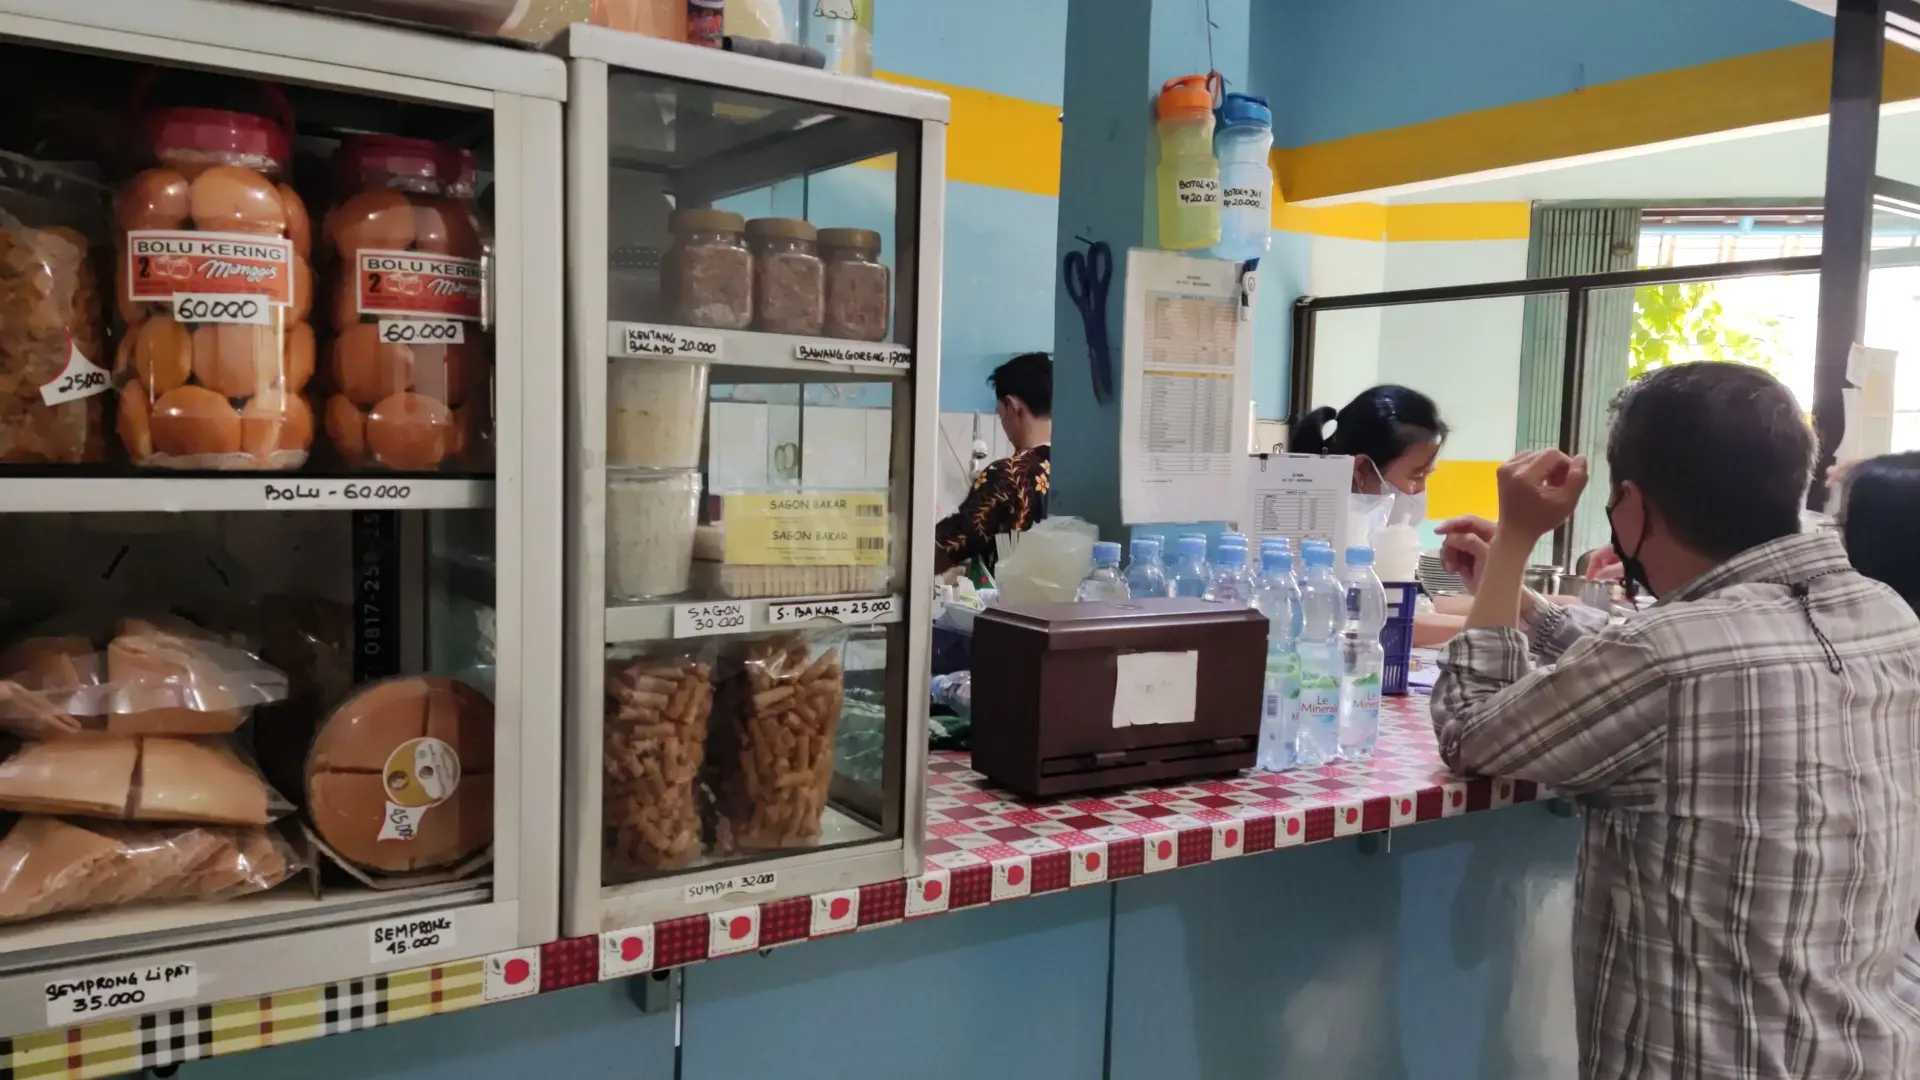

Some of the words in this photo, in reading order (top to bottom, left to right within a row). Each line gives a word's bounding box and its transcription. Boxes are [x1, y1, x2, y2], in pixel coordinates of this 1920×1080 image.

[137, 241, 193, 253] BOLU
[201, 242, 282, 260] KERING
[368, 258, 423, 272] BOLU
[384, 323, 457, 341] 60.000
[628, 329, 677, 345] KENTANG
[629, 340, 675, 355] BALADO
[800, 345, 843, 360] BAWANG
[769, 499, 810, 510] SAGON
[813, 499, 847, 509] BAKAR
[771, 530, 812, 541] SAGON
[815, 531, 848, 541] BAKAR
[688, 604, 741, 619] SAGON
[794, 606, 840, 618] BAKAR
[851, 601, 891, 614] 25.000
[1317, 695, 1328, 705] Le
[374, 917, 452, 943] SEMPRONG
[386, 934, 440, 955] 45.000
[45, 972, 138, 1001] SEMPRONG
[72, 990, 145, 1012] 35.000
